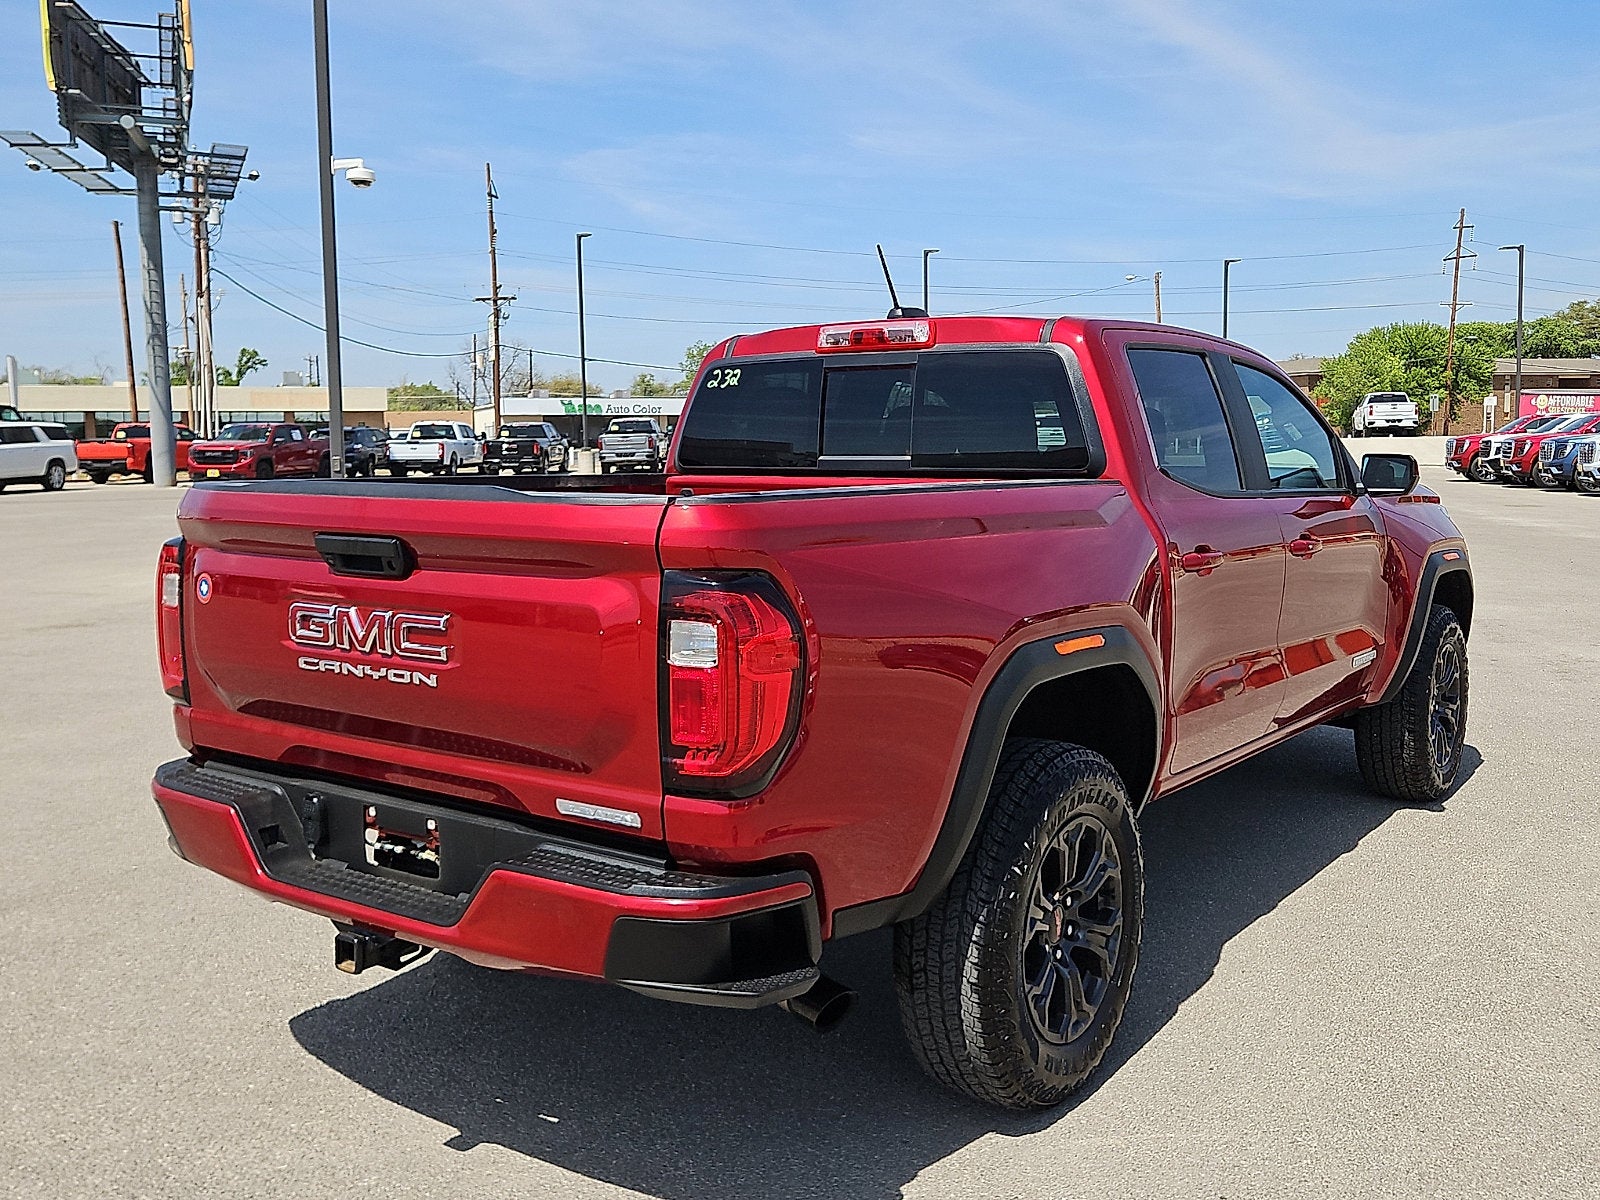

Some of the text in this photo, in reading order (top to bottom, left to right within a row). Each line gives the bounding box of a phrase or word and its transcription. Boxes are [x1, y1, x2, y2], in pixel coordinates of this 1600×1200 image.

[707, 368, 741, 389] 232
[605, 404, 630, 414] Auto
[632, 404, 663, 414] Color
[1548, 395, 1595, 408] AFFORDABLE
[288, 602, 453, 662] GMC
[297, 656, 439, 688] CANYON
